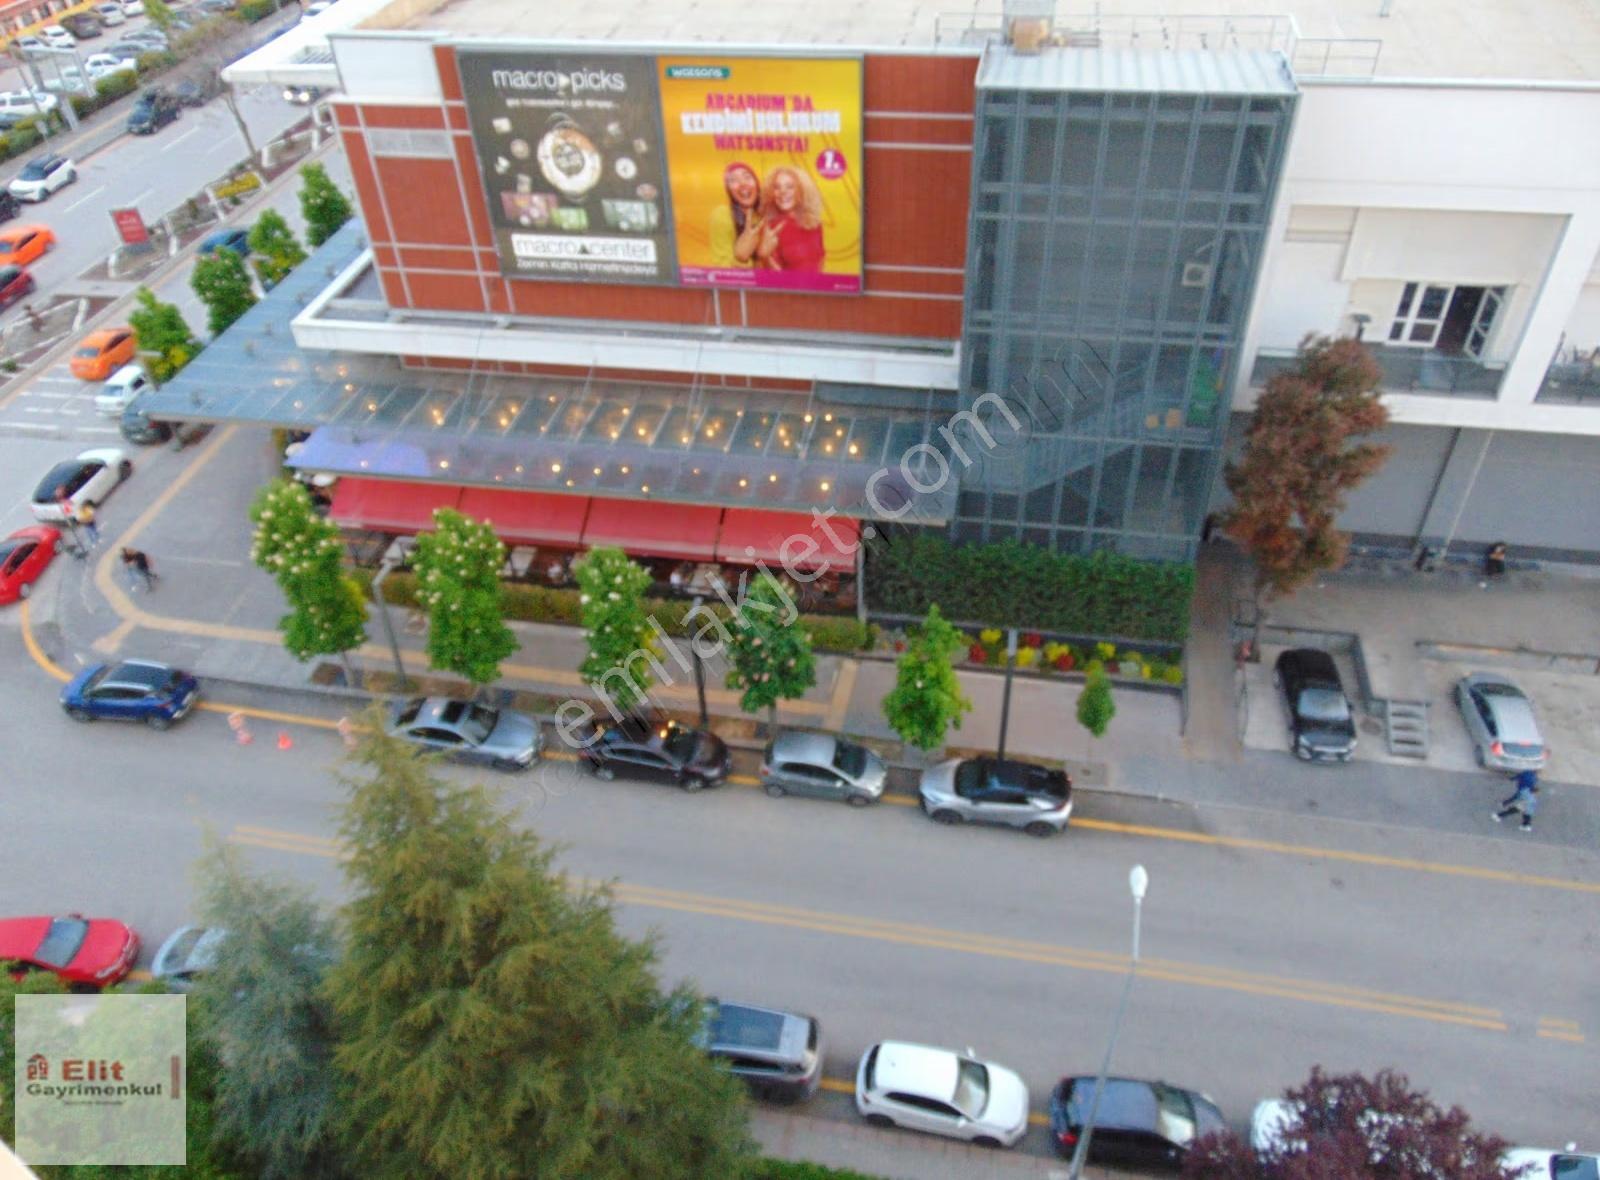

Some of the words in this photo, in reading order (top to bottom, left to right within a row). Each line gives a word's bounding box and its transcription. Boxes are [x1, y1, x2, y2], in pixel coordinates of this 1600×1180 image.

[492, 69, 557, 89] macro
[570, 68, 627, 93] picks
[515, 237, 580, 256] macro
[587, 241, 651, 259] center
